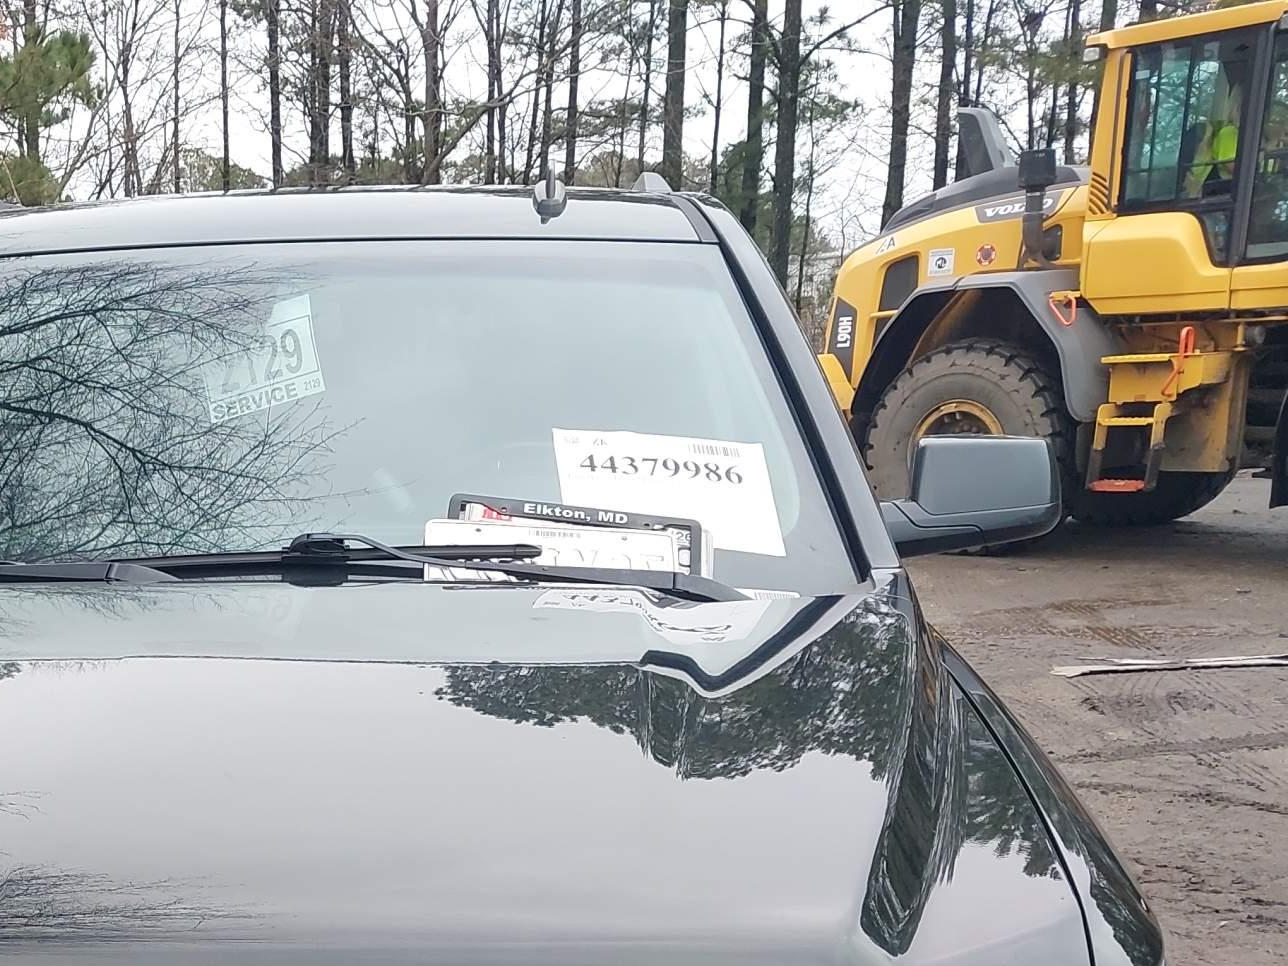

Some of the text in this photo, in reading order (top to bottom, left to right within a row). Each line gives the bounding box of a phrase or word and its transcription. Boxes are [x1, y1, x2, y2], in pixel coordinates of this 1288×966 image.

[984, 199, 1053, 217] VOLO
[837, 317, 852, 348] L90H
[212, 382, 297, 419] SERVICE
[579, 453, 743, 484] 44379986
[524, 503, 591, 521] Elkton,
[598, 512, 628, 524] MD
